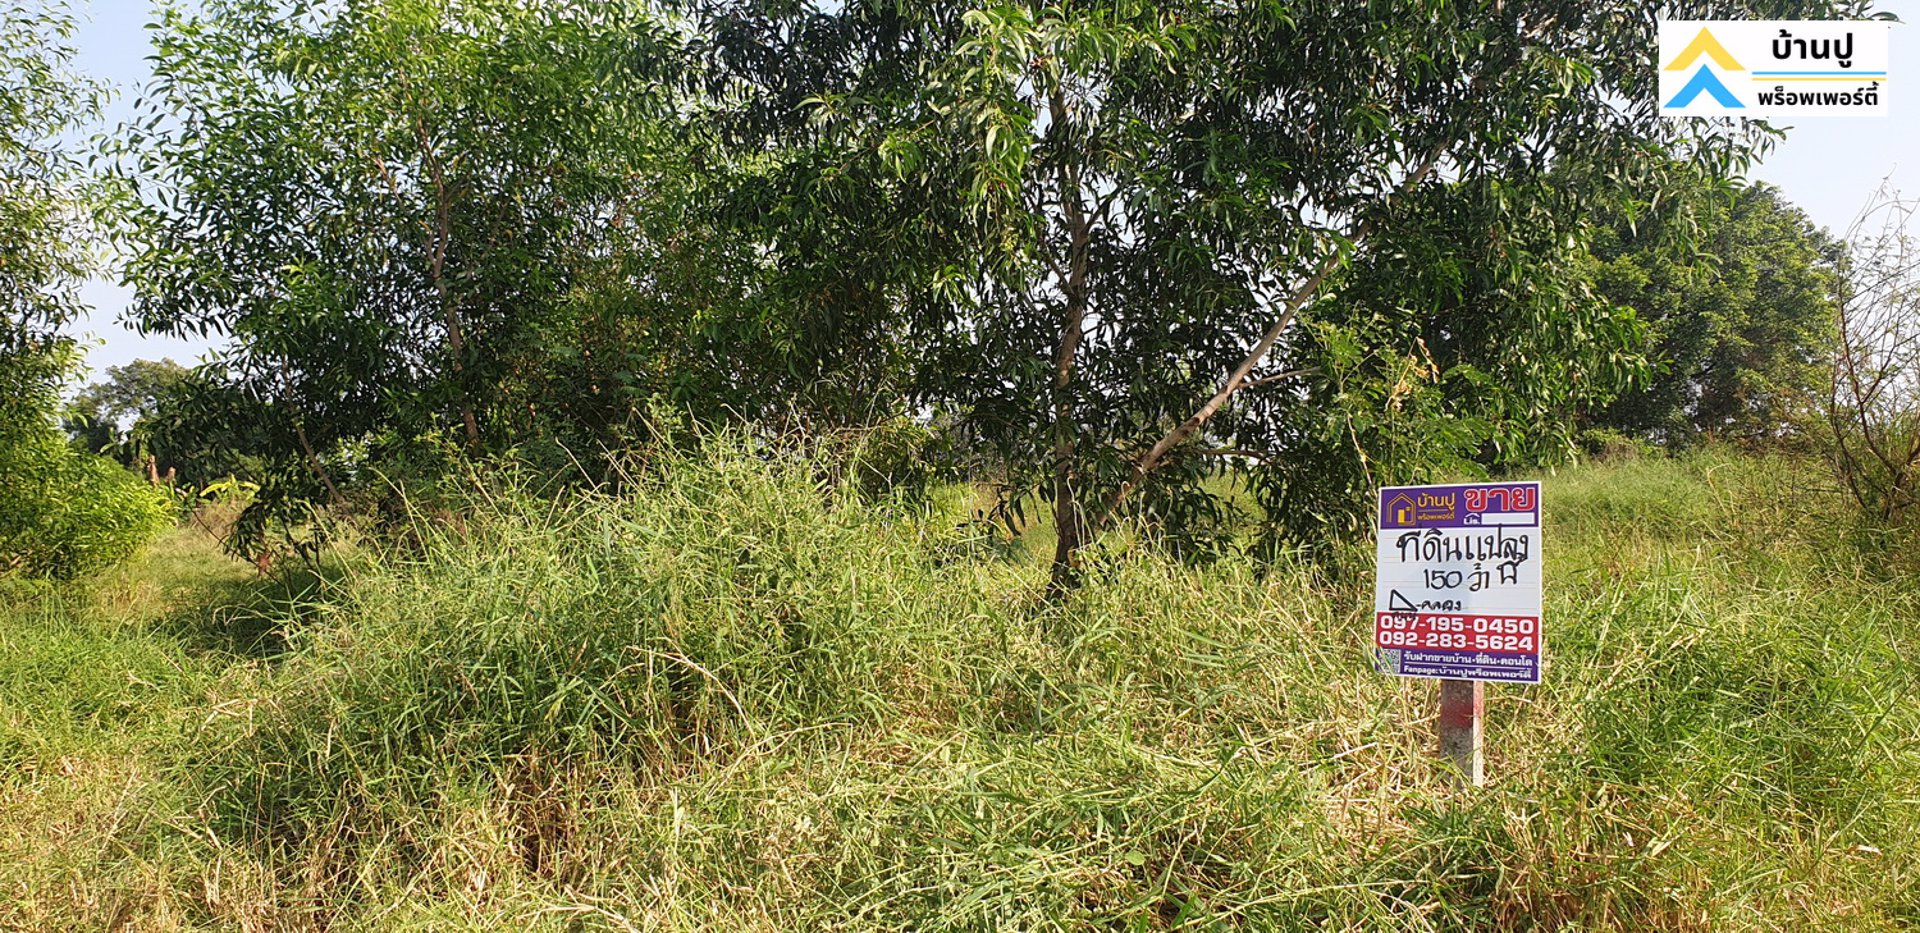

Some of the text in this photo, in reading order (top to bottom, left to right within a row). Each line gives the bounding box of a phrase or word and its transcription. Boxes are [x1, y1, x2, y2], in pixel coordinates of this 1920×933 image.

[1417, 492, 1455, 510] บ้านปู
[1464, 487, 1536, 512] ขาย
[1423, 568, 1463, 590] 150
[1380, 614, 1534, 634] 097-195-0450
[1379, 631, 1534, 651] 092-283-5624
